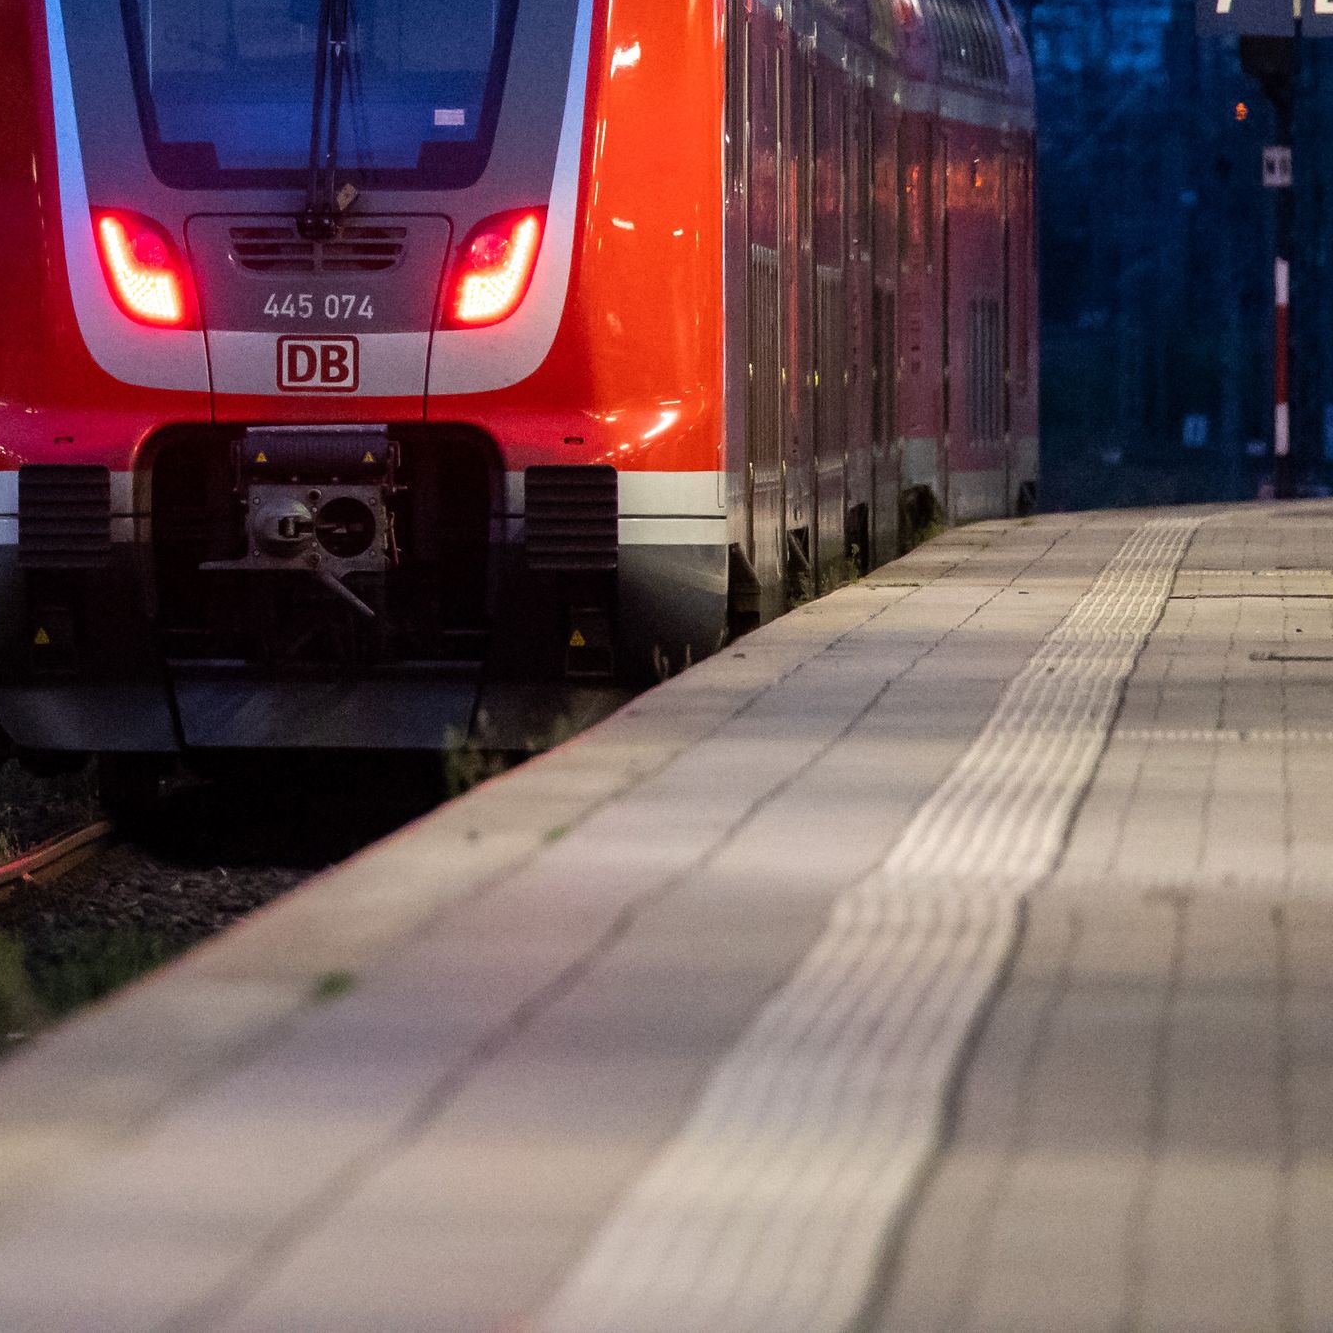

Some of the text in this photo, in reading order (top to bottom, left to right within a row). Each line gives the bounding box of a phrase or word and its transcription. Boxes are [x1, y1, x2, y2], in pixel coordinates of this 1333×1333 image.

[263, 293, 374, 319] 445 074
[287, 344, 350, 383] DB
